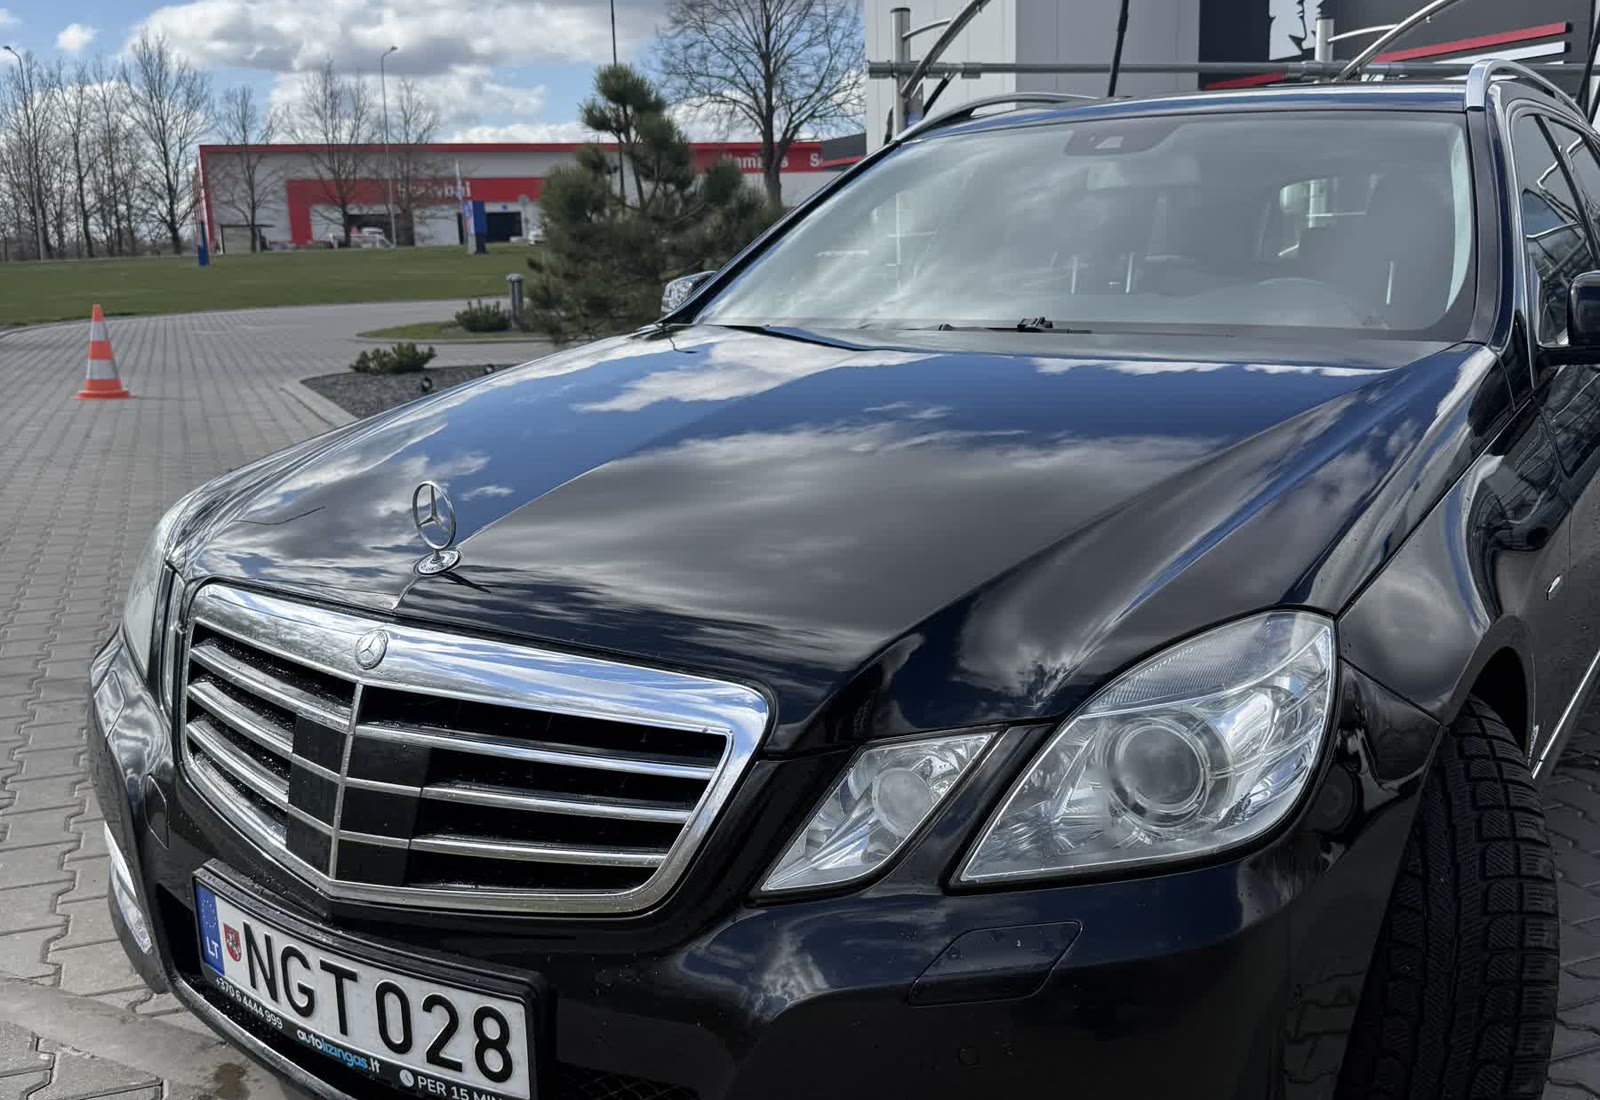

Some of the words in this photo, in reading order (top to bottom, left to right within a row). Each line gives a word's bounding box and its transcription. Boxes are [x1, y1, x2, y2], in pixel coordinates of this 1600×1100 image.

[810, 153, 824, 168] S
[206, 936, 219, 959] LT
[216, 976, 235, 998] +370
[235, 990, 242, 1002] 6
[264, 1009, 284, 1029] 999
[243, 921, 358, 1036] NGT
[375, 981, 513, 1083] 028
[297, 1029, 381, 1073] autolizingas.lt
[417, 1076, 447, 1096] PER
[451, 1086, 470, 1100] 15
